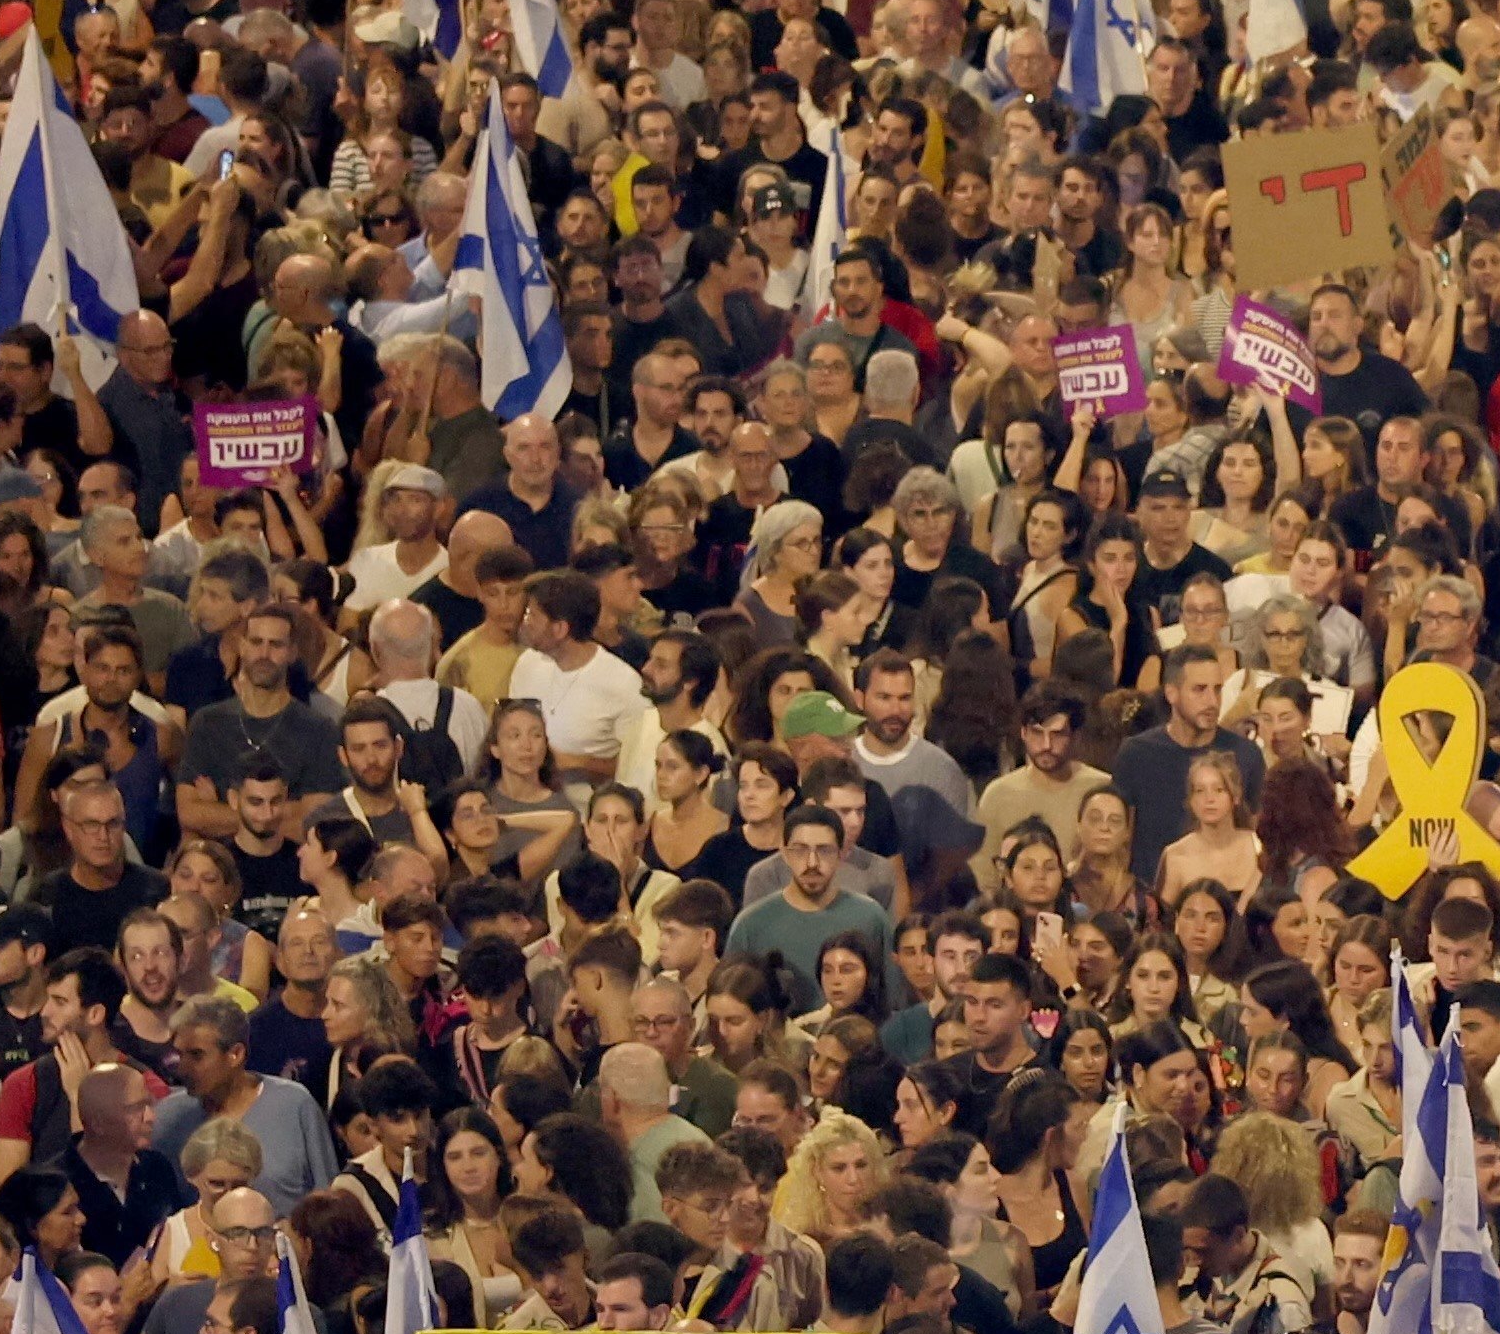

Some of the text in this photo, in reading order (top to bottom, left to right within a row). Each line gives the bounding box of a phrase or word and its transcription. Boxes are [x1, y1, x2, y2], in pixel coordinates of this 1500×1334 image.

[1259, 162, 1367, 238] די
[1241, 338, 1316, 388] עכשיו
[1060, 371, 1121, 396] עכשיו
[252, 411, 273, 424] את
[214, 439, 300, 462] עכשיו
[1409, 818, 1456, 848] NOW
